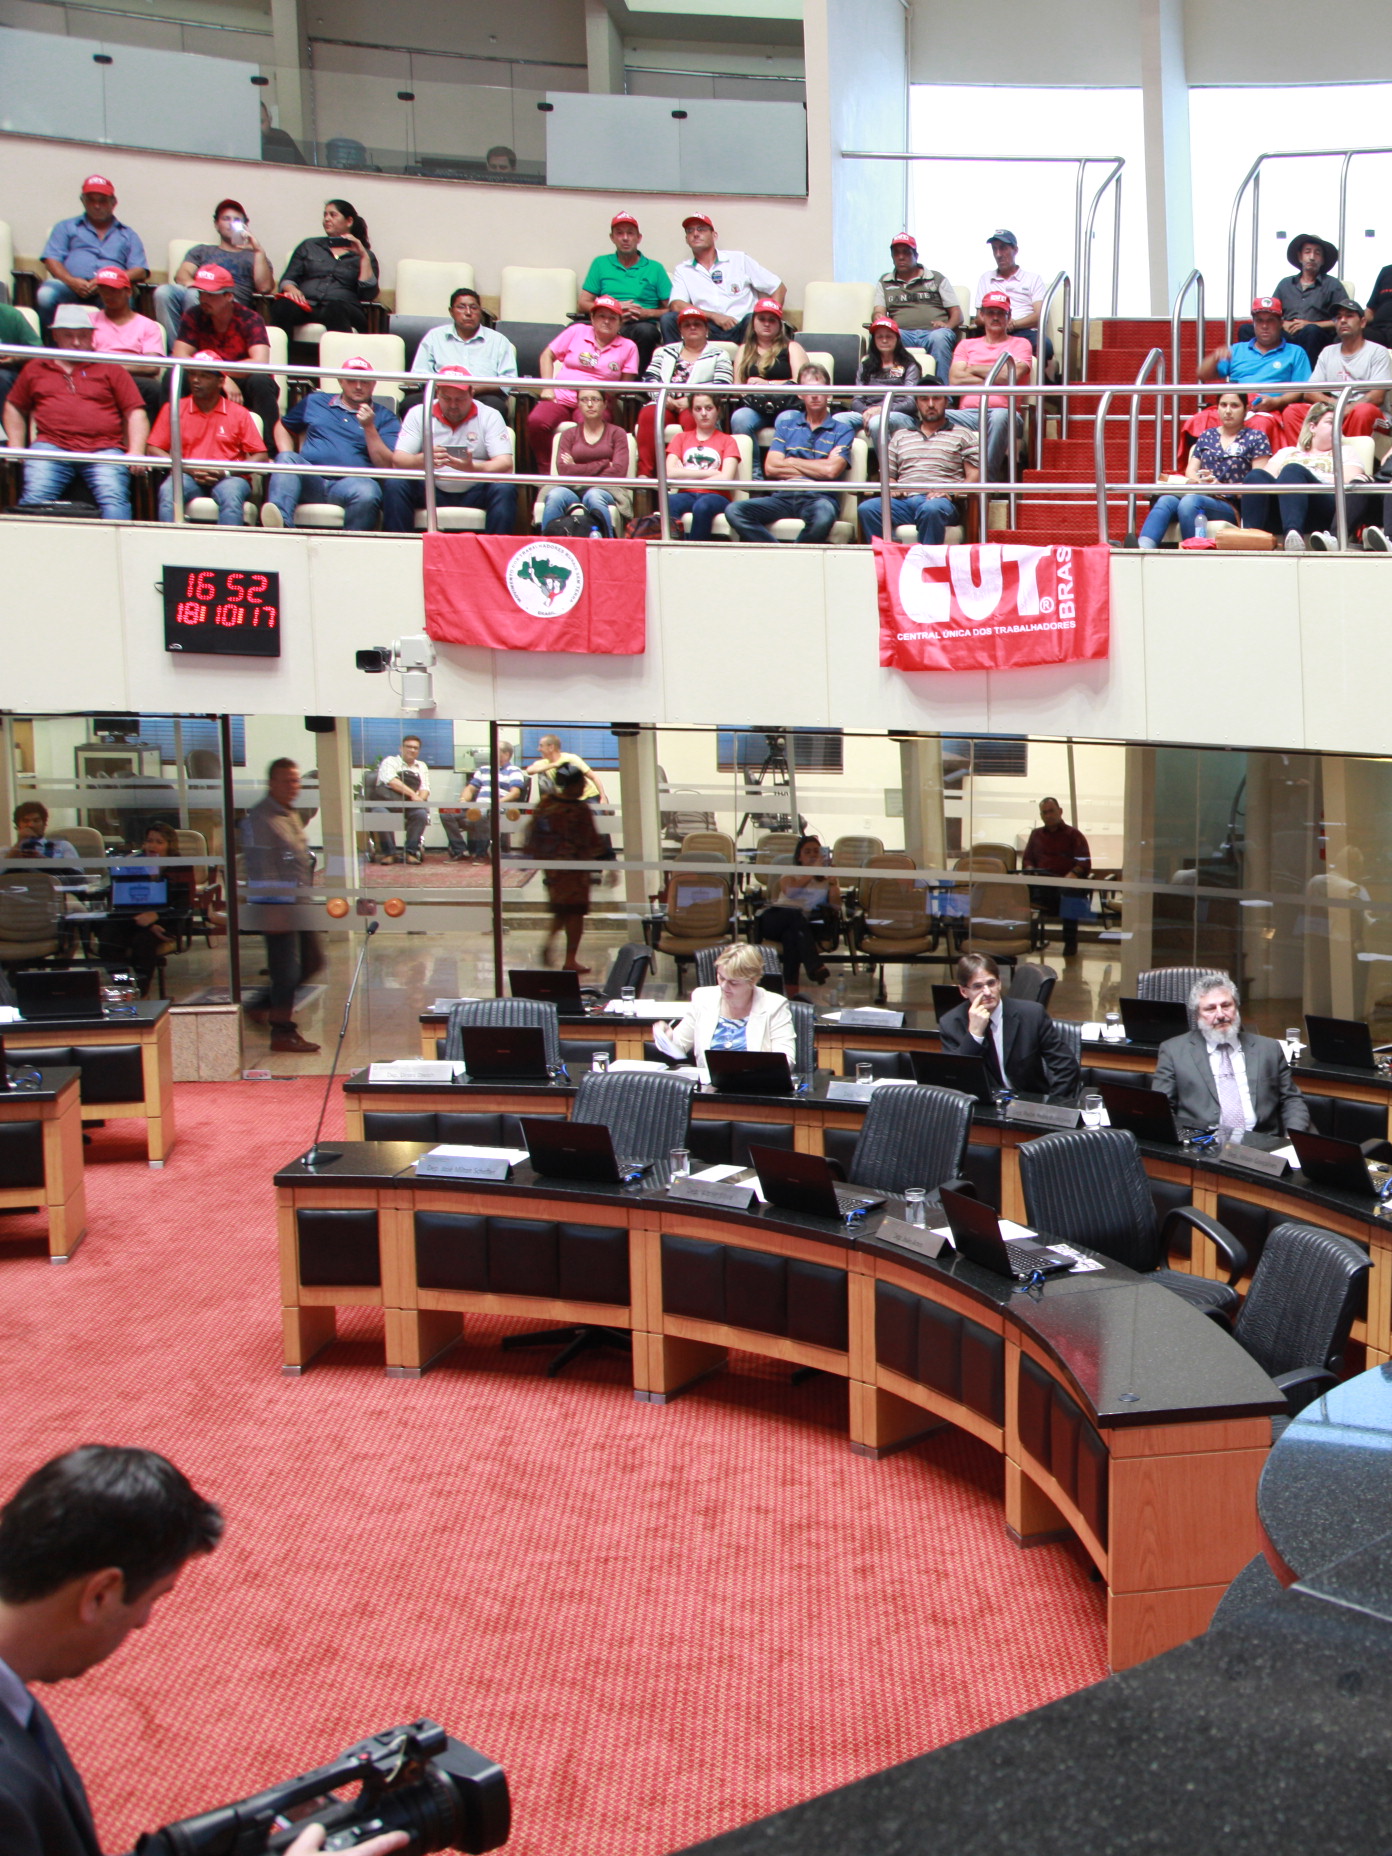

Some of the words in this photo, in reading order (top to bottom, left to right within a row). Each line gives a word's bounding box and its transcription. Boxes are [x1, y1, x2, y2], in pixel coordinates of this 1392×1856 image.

[187, 571, 216, 601] 16
[225, 573, 268, 604] 52
[899, 544, 1053, 624] CUT
[897, 631, 941, 641] CENTRAL
[942, 627, 972, 638] ÚNICA
[972, 627, 993, 637] DOS
[993, 620, 1077, 636] TRABALHADORES
